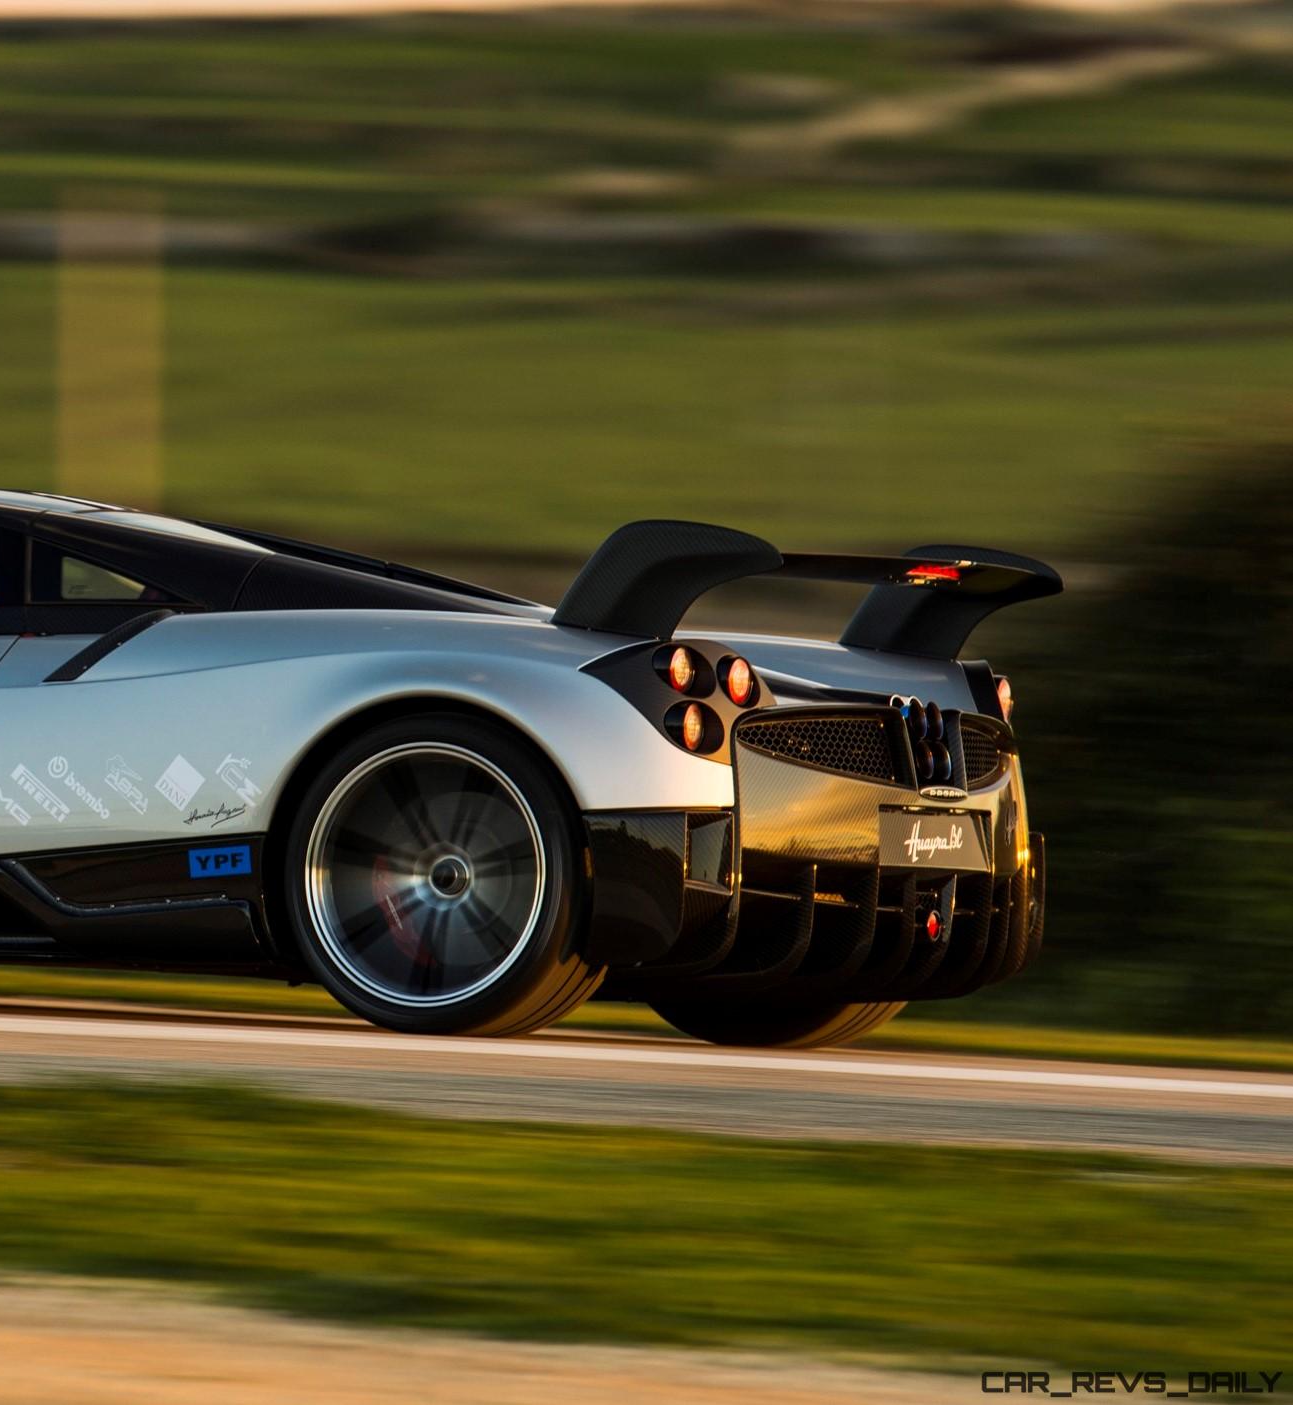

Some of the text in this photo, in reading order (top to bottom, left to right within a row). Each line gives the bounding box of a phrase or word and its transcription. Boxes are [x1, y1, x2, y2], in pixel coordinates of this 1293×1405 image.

[10, 763, 70, 823] PIRELLI
[63, 771, 110, 820] brembo
[195, 852, 245, 871] YPF
[904, 819, 948, 863] Huayra
